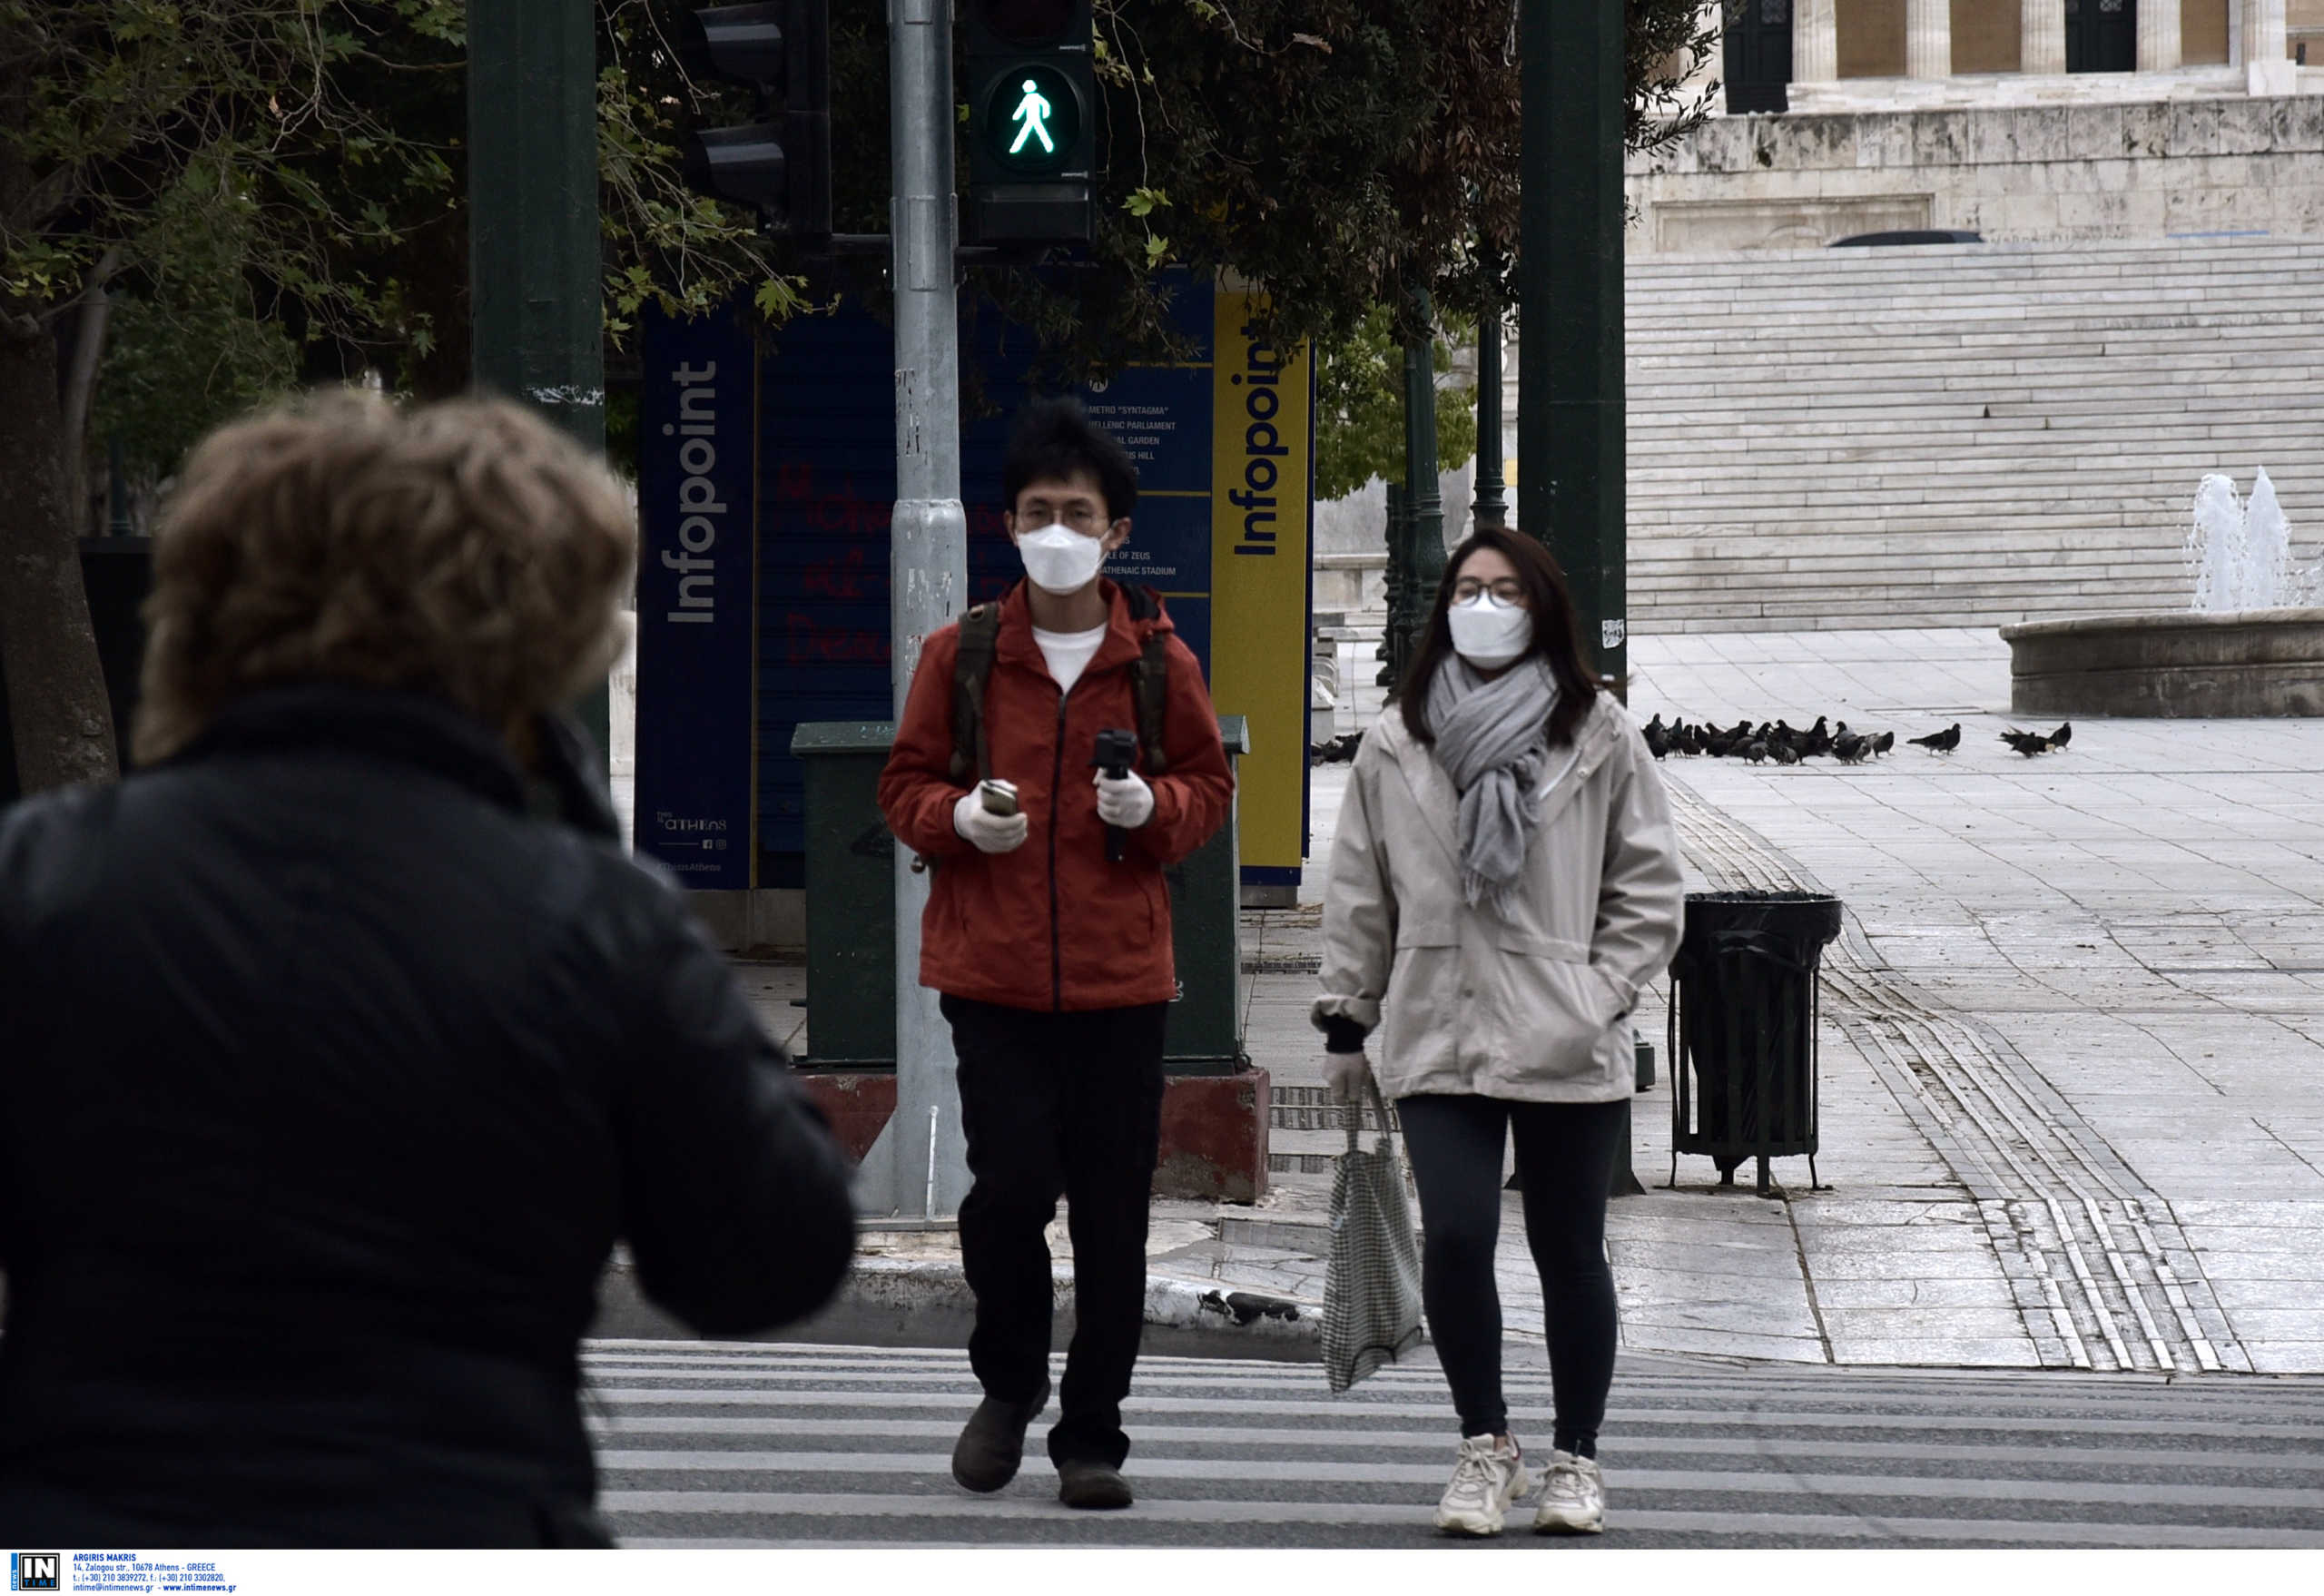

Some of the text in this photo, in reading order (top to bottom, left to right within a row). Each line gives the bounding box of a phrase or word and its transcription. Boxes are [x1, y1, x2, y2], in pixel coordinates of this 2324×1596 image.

[1088, 406, 1116, 415] METRO
[1127, 421, 1177, 430] PARLIAMENT
[1128, 436, 1161, 446] GARDEN
[1137, 450, 1156, 460] HILL
[661, 360, 727, 624] Infopoint
[1119, 551, 1129, 560] OF
[1131, 551, 1151, 560] ZEUS
[1101, 566, 1177, 576] ATHENAIC STADIUM
